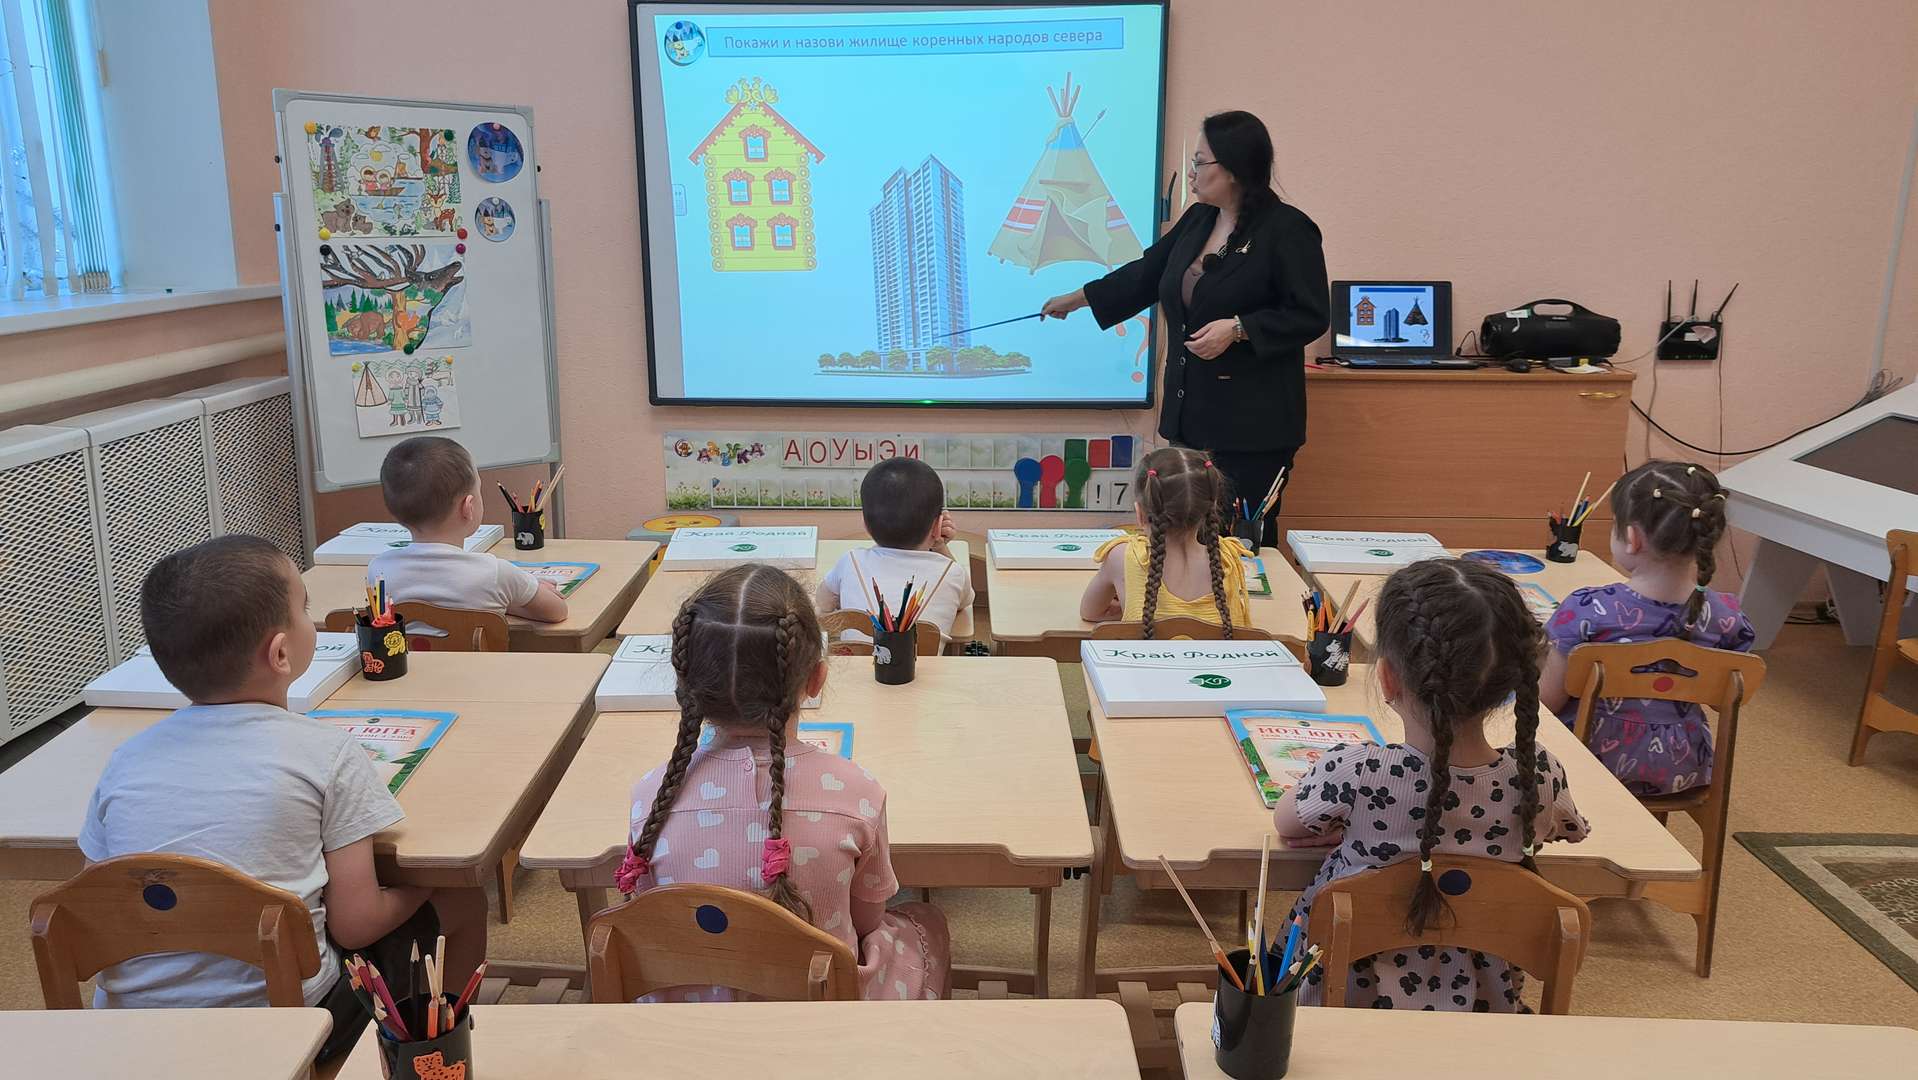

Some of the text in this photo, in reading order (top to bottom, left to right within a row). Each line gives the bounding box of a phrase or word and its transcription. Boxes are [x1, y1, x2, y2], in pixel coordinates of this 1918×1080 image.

[724, 30, 1103, 49] Покажи и назови жилище коренных народов севера
[1303, 534, 1428, 544] Край Родной
[632, 643, 673, 655] Кр
[1103, 648, 1280, 661] Край Родной
[1258, 726, 1302, 736] МОЯ
[1308, 730, 1362, 740] ЮГРА
